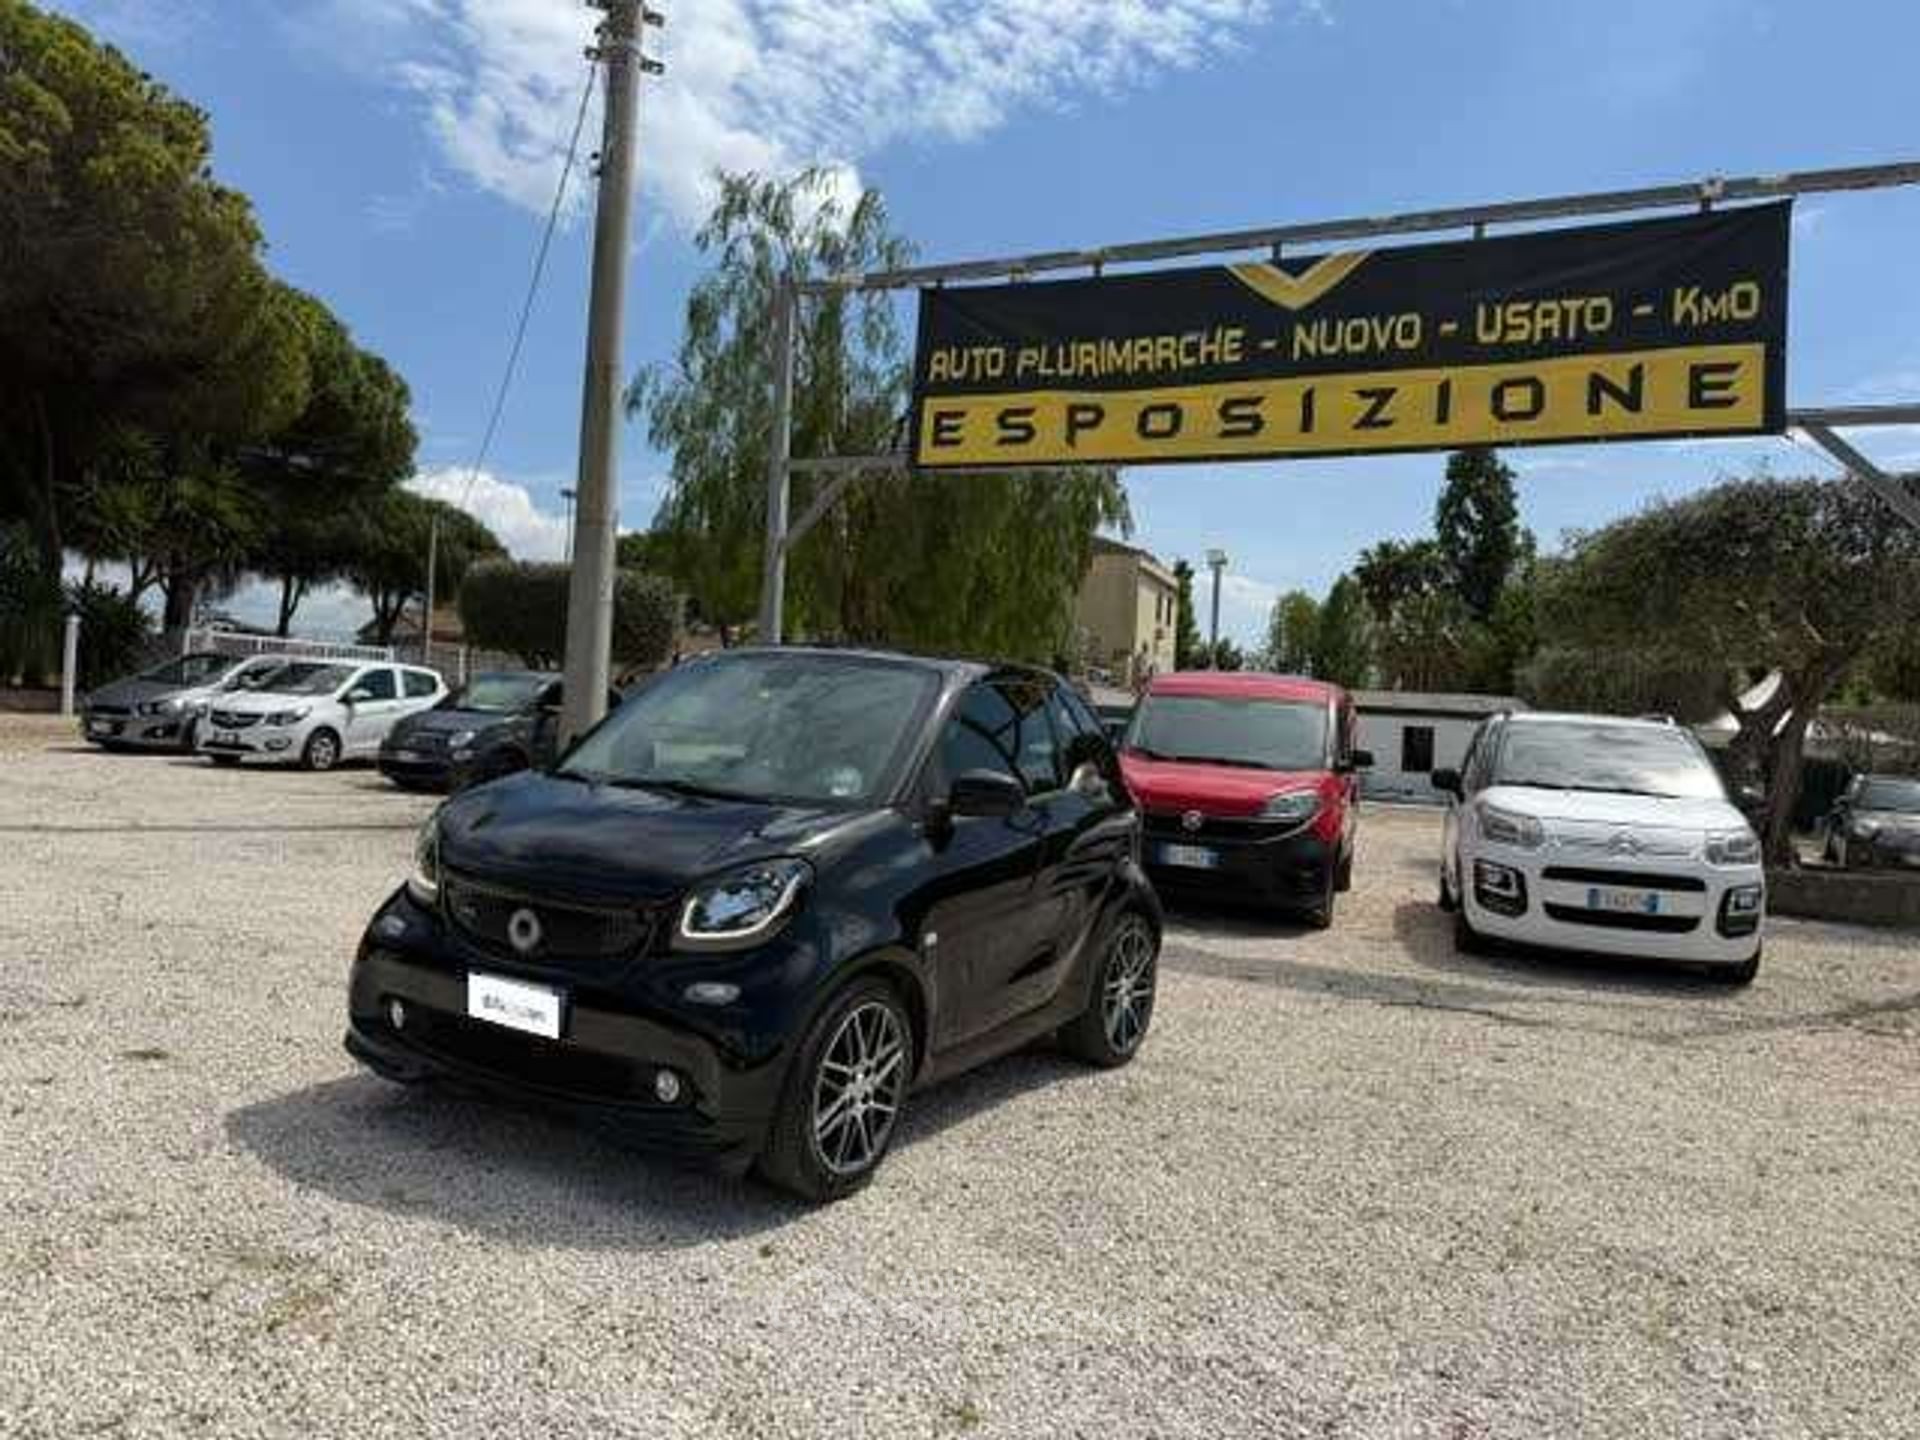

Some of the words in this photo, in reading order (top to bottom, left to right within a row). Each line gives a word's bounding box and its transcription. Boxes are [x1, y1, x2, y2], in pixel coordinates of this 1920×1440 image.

[929, 347, 1004, 382] AUTO
[1017, 325, 1245, 378] PLURIMARCHE
[1293, 312, 1420, 361] NUOVO
[1476, 296, 1613, 345] USATO
[931, 363, 1742, 448] ESPOSIZIONE
